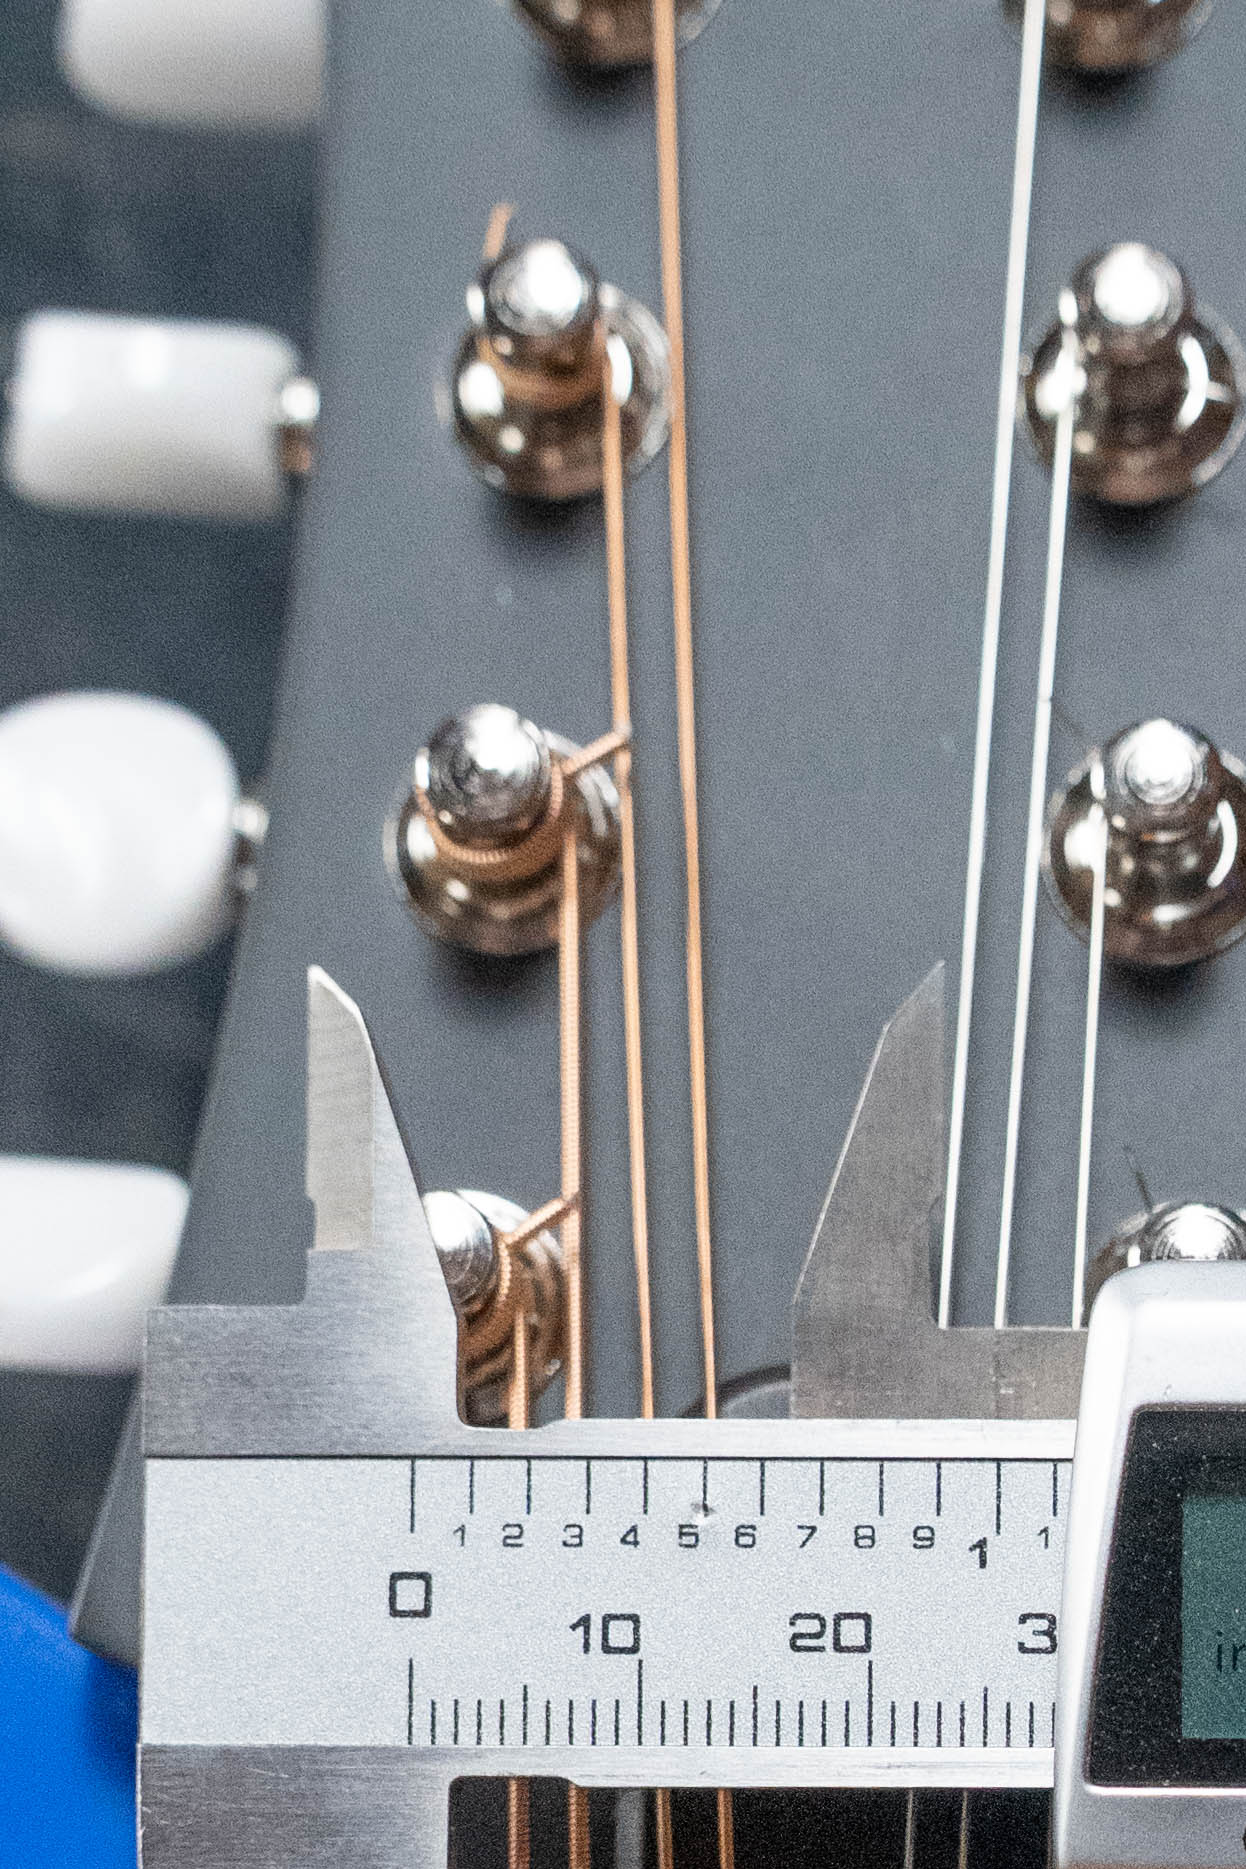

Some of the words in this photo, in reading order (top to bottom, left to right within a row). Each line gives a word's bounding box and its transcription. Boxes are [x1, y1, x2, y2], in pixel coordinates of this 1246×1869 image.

[452, 1524, 468, 1548] 1
[502, 1523, 525, 1549] 2
[561, 1523, 584, 1548] 3
[619, 1524, 641, 1548] 4
[678, 1523, 700, 1549] 5
[734, 1524, 757, 1549] 6
[797, 1524, 818, 1548] 7
[853, 1524, 876, 1549] 8
[912, 1525, 936, 1550] 9
[968, 1536, 989, 1570] 1
[388, 1571, 433, 1619] 0
[569, 1612, 641, 1655] 10
[788, 1611, 873, 1655] 20
